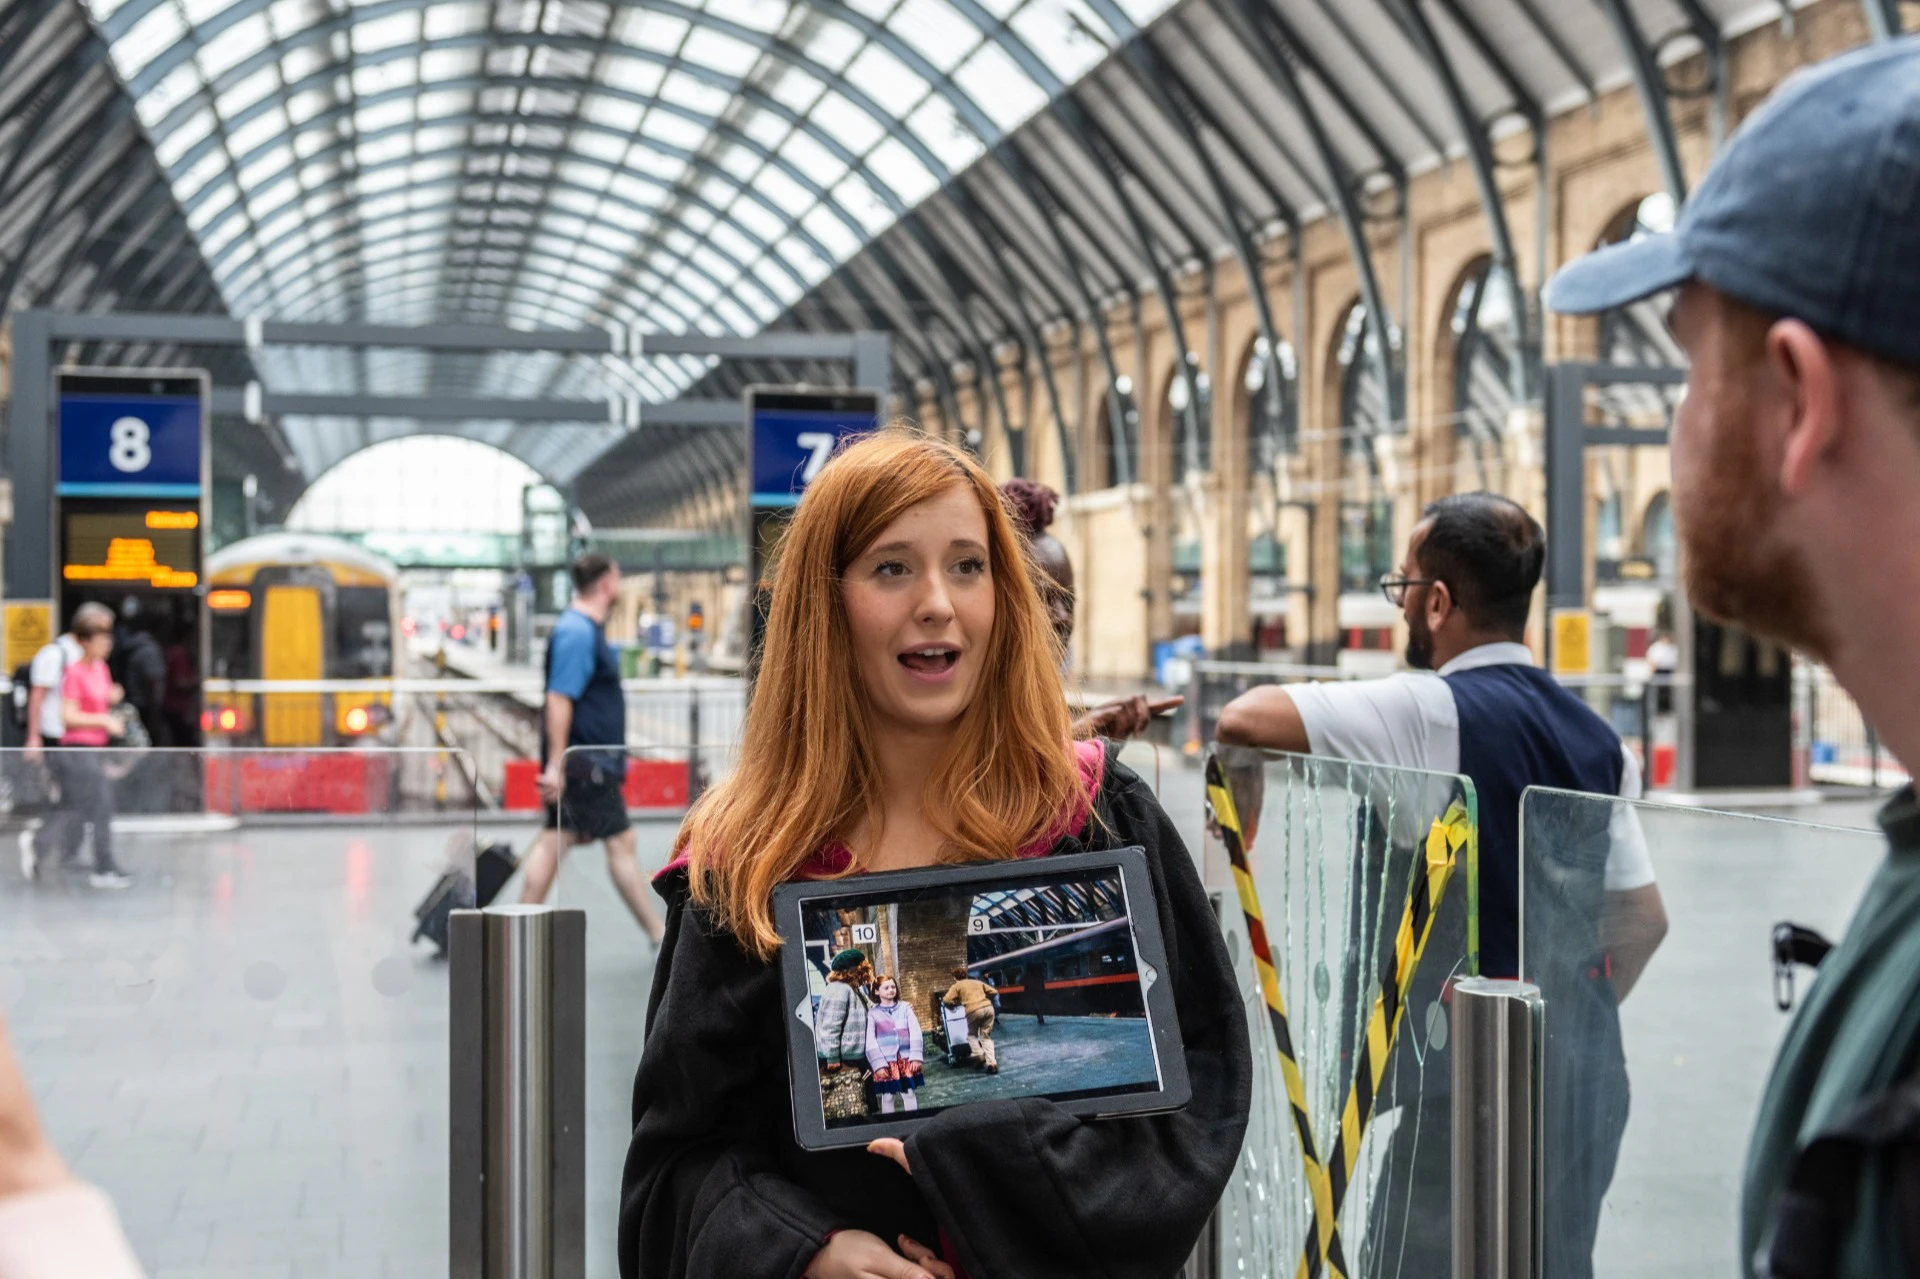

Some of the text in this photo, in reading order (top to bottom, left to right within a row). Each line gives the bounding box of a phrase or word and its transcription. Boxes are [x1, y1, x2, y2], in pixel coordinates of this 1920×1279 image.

[109, 416, 152, 473] 8
[797, 432, 835, 483] 7
[855, 926, 875, 941] 10
[973, 918, 984, 932] 9
